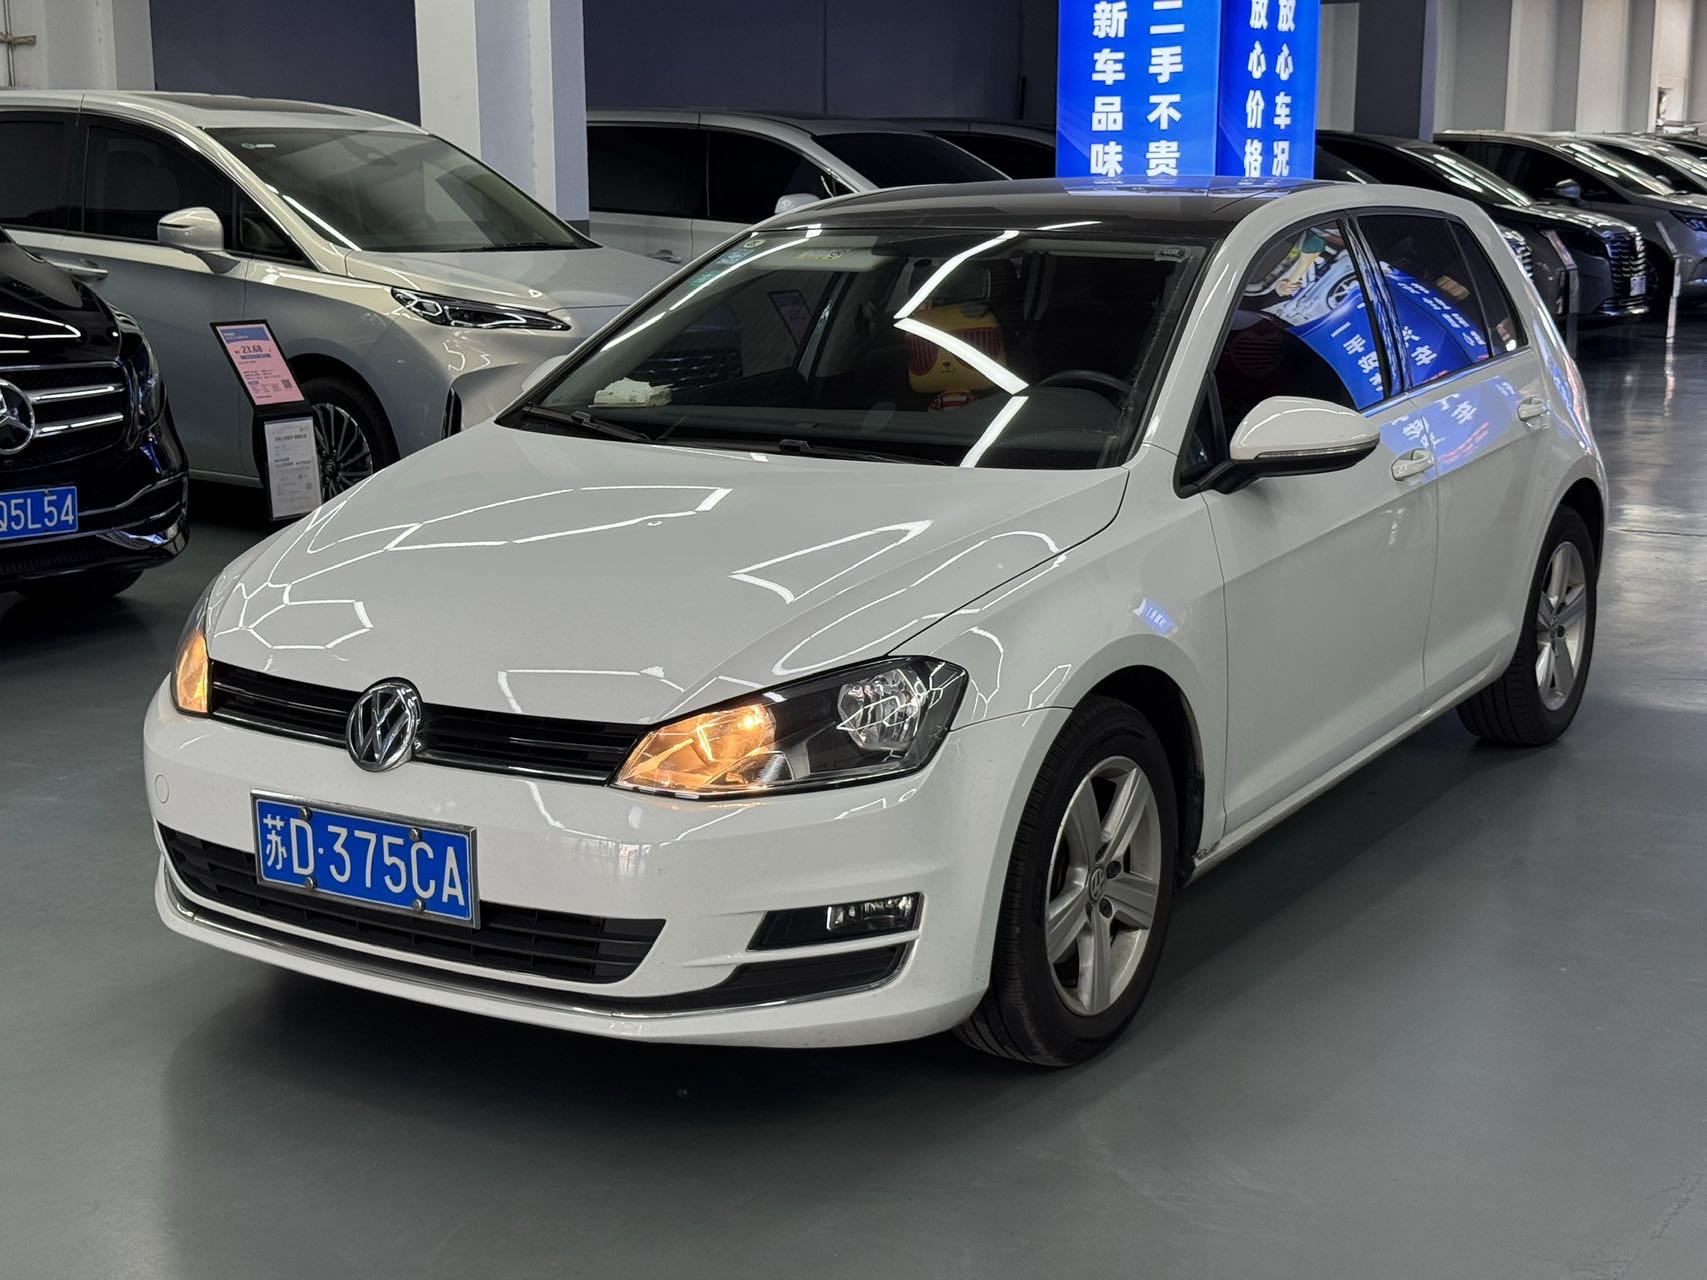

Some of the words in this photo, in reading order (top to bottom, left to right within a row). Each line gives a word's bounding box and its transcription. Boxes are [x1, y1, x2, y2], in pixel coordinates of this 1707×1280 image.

[1090, 1, 1127, 177] 新车品味
[1145, 0, 1185, 177] 二手不贵
[1243, 0, 1268, 178] 放心价格
[1272, 0, 1296, 177] 放心车况
[0, 493, 74, 532] Q5L54
[263, 814, 465, 906] 苏D·375CA
